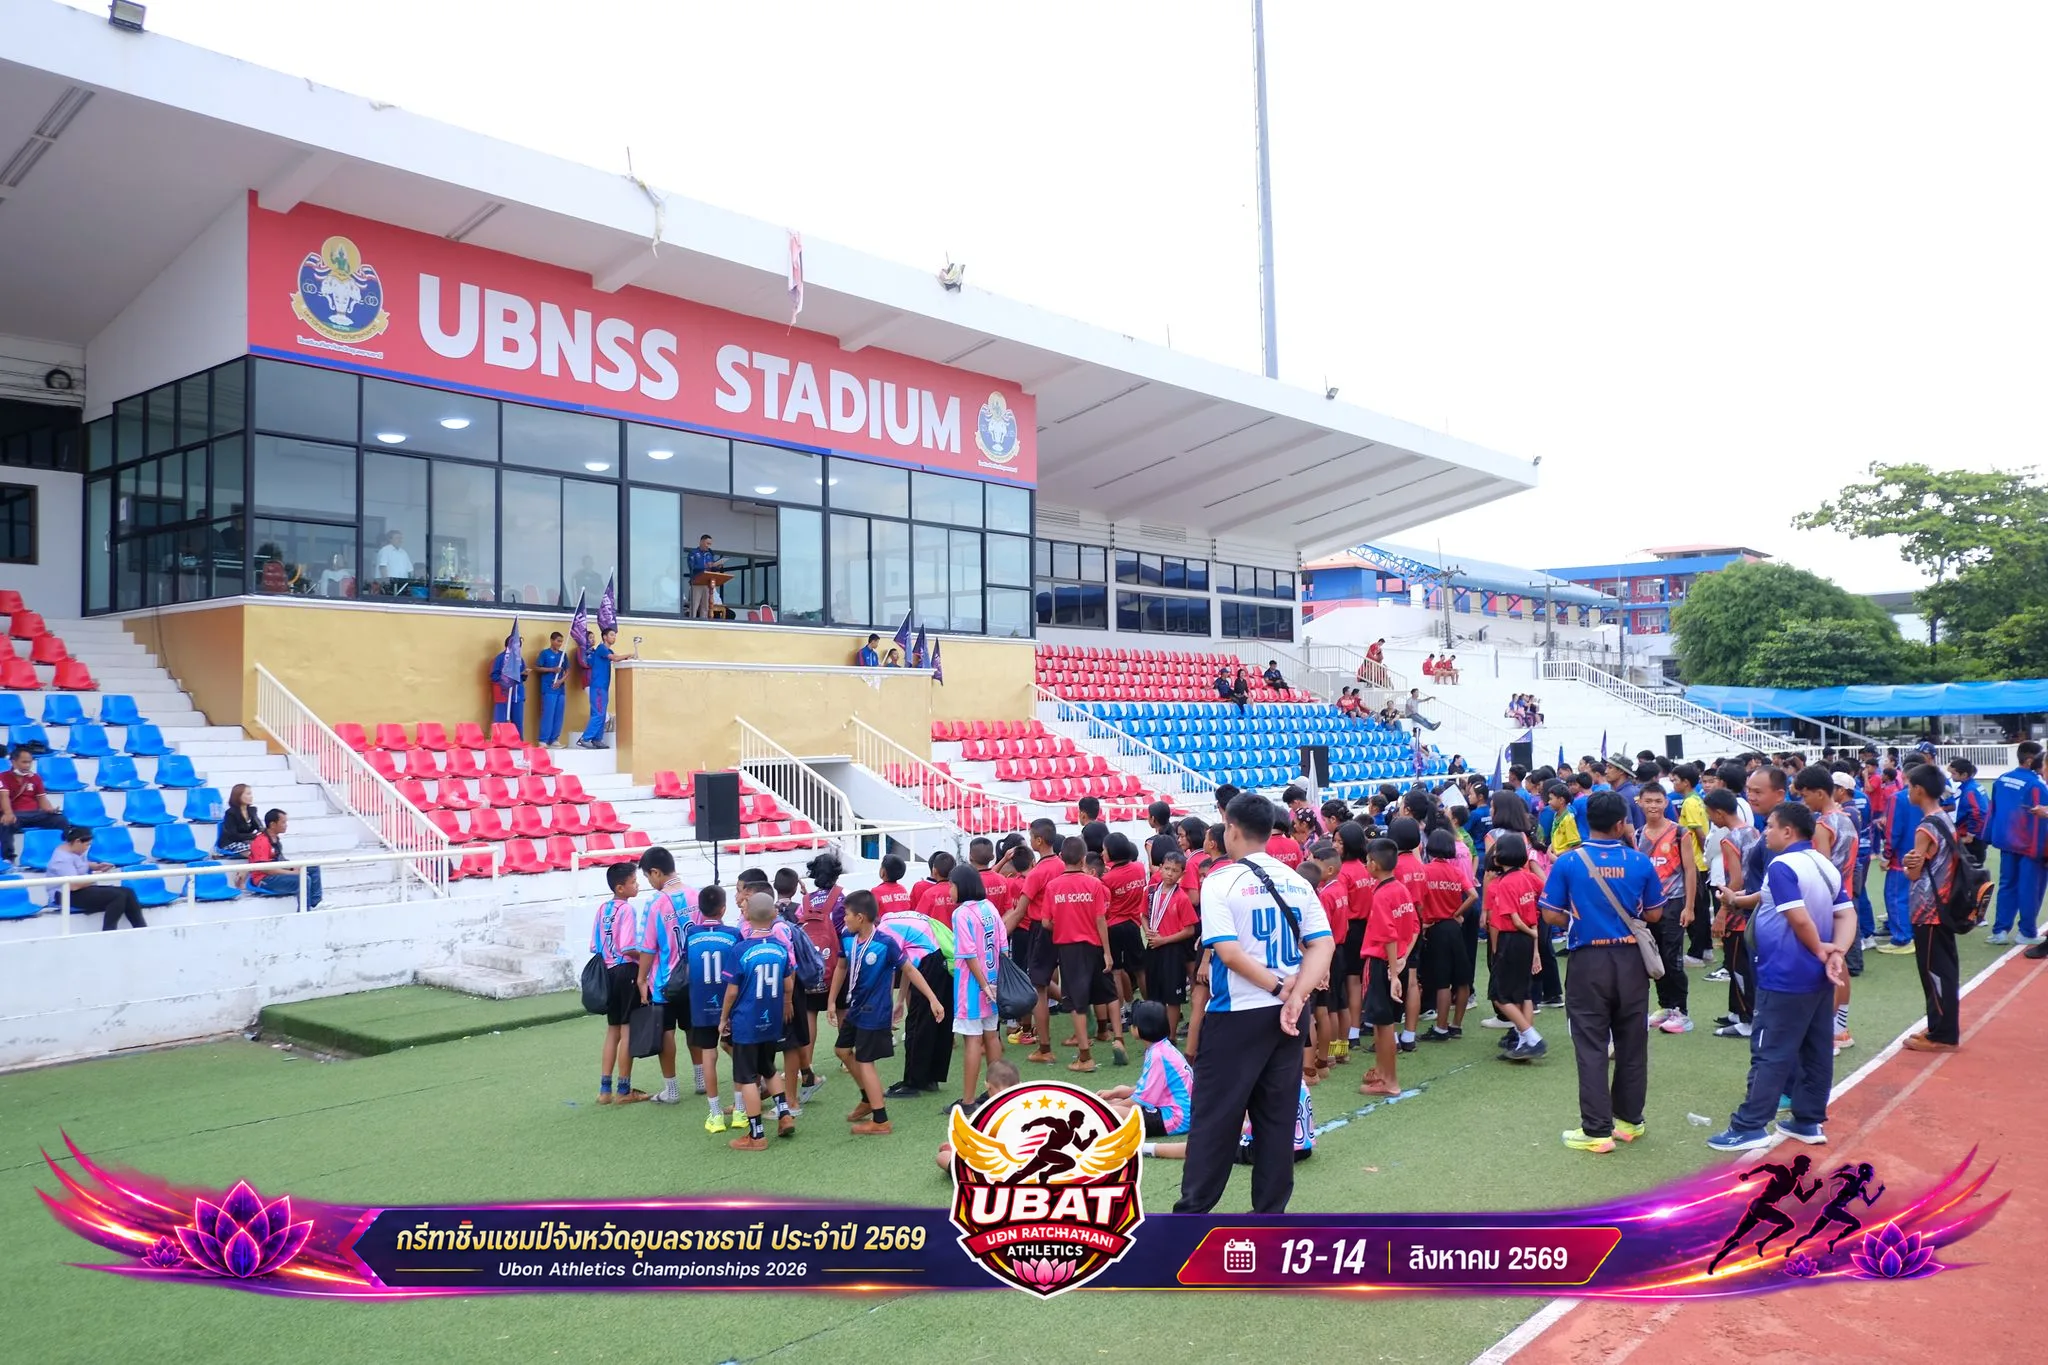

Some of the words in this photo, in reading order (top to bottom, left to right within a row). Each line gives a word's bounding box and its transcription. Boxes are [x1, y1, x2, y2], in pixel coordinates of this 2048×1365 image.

[419, 273, 679, 401] UBNSS
[714, 343, 962, 454] STADIUM
[1067, 892, 1094, 902] SCHOOL
[1438, 880, 1462, 892] SCHOOL
[700, 950, 722, 985] 11
[754, 963, 780, 1000] 14
